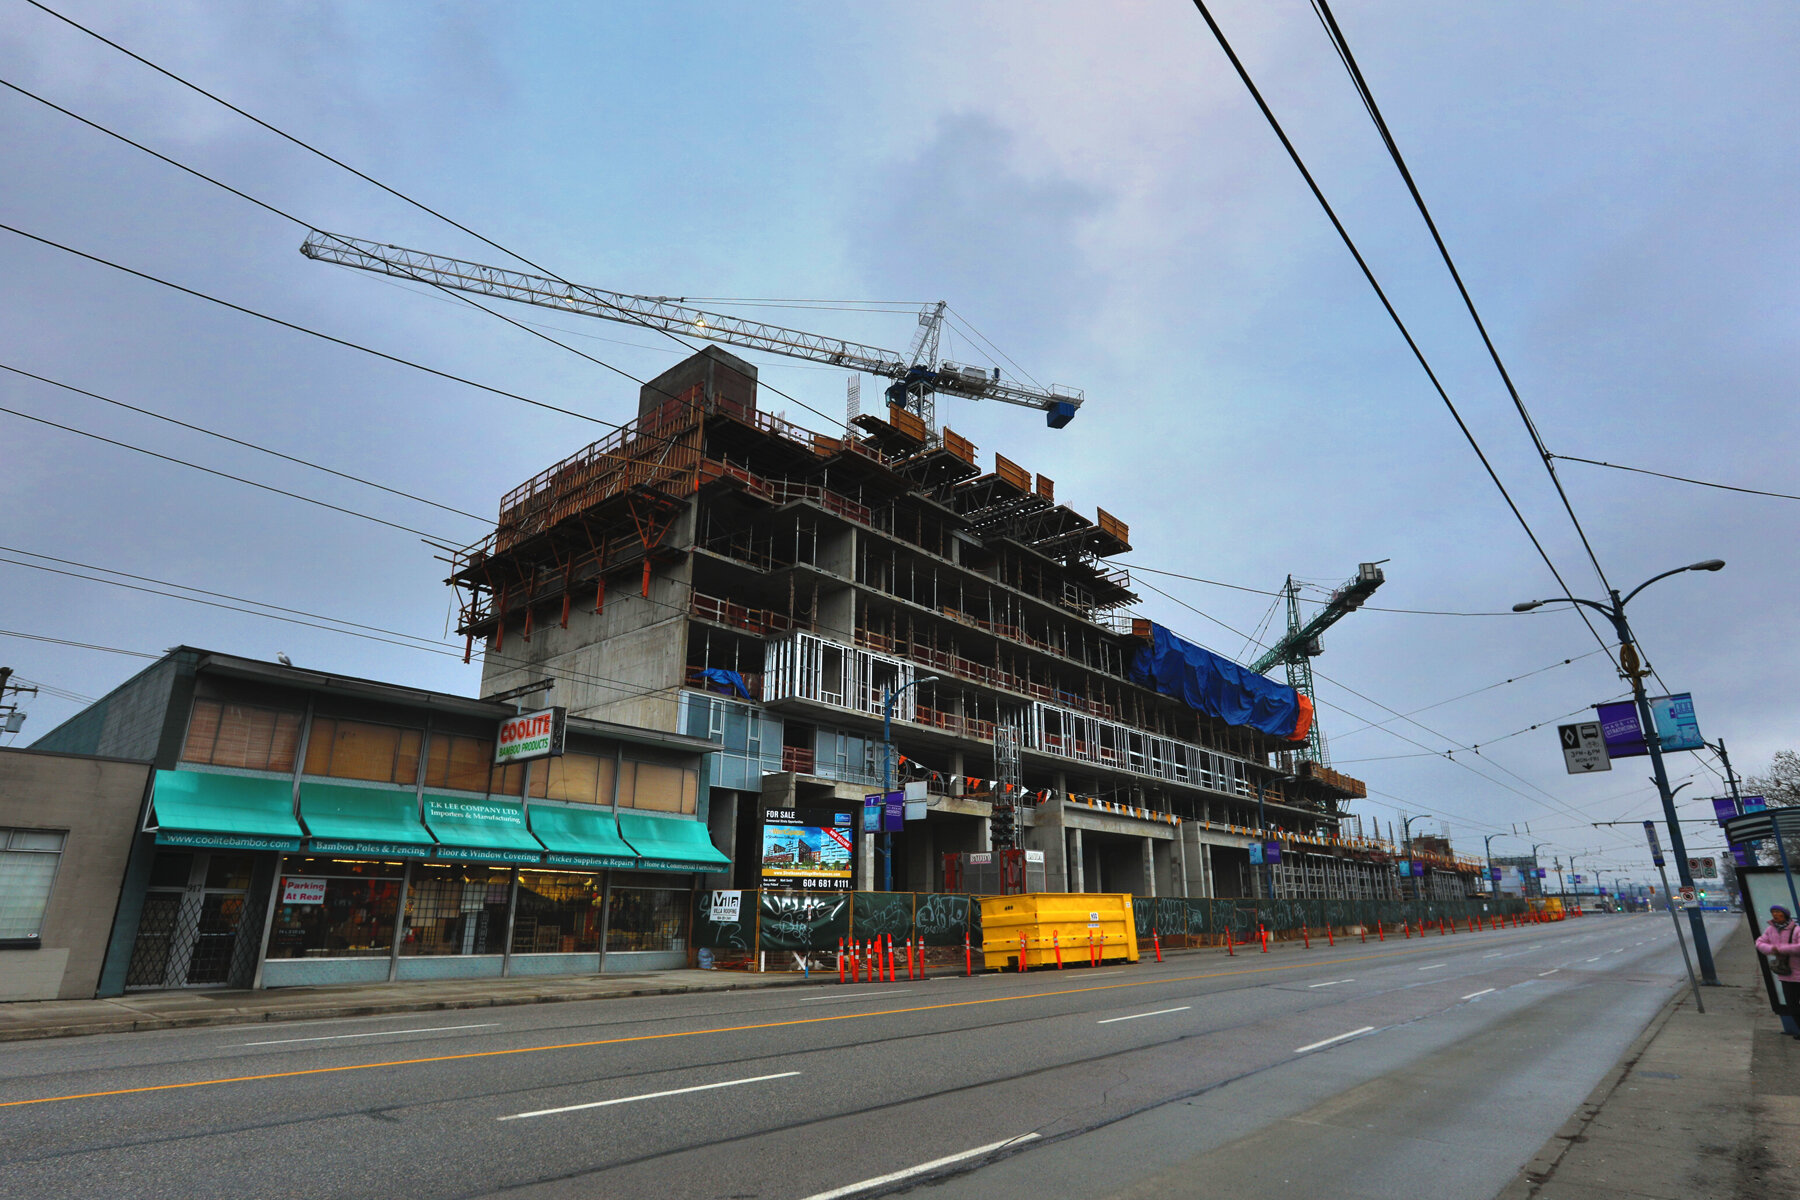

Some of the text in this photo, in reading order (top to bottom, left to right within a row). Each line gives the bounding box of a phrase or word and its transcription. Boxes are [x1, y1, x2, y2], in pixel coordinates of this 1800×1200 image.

[501, 713, 551, 744] COOLITE
[499, 738, 549, 757] BAMBOO PRODUCTS
[460, 804, 501, 814] COMPANY
[502, 808, 520, 816] LTD.
[766, 810, 796, 819] FOR SALE
[430, 809, 464, 818] Importers
[473, 812, 521, 824] Manufacturing
[316, 841, 425, 856] Bamboo Poles & Fencing
[438, 848, 540, 863] Floor & Window Coverings
[549, 855, 634, 867] Wicker Supplies & Repairs
[666, 862, 696, 870] Commercial
[695, 864, 724, 873] Furnishings
[287, 881, 325, 892] Parking
[803, 879, 849, 888] 604 681 4111
[285, 892, 323, 901] At Rear
[713, 891, 739, 907] Villa
